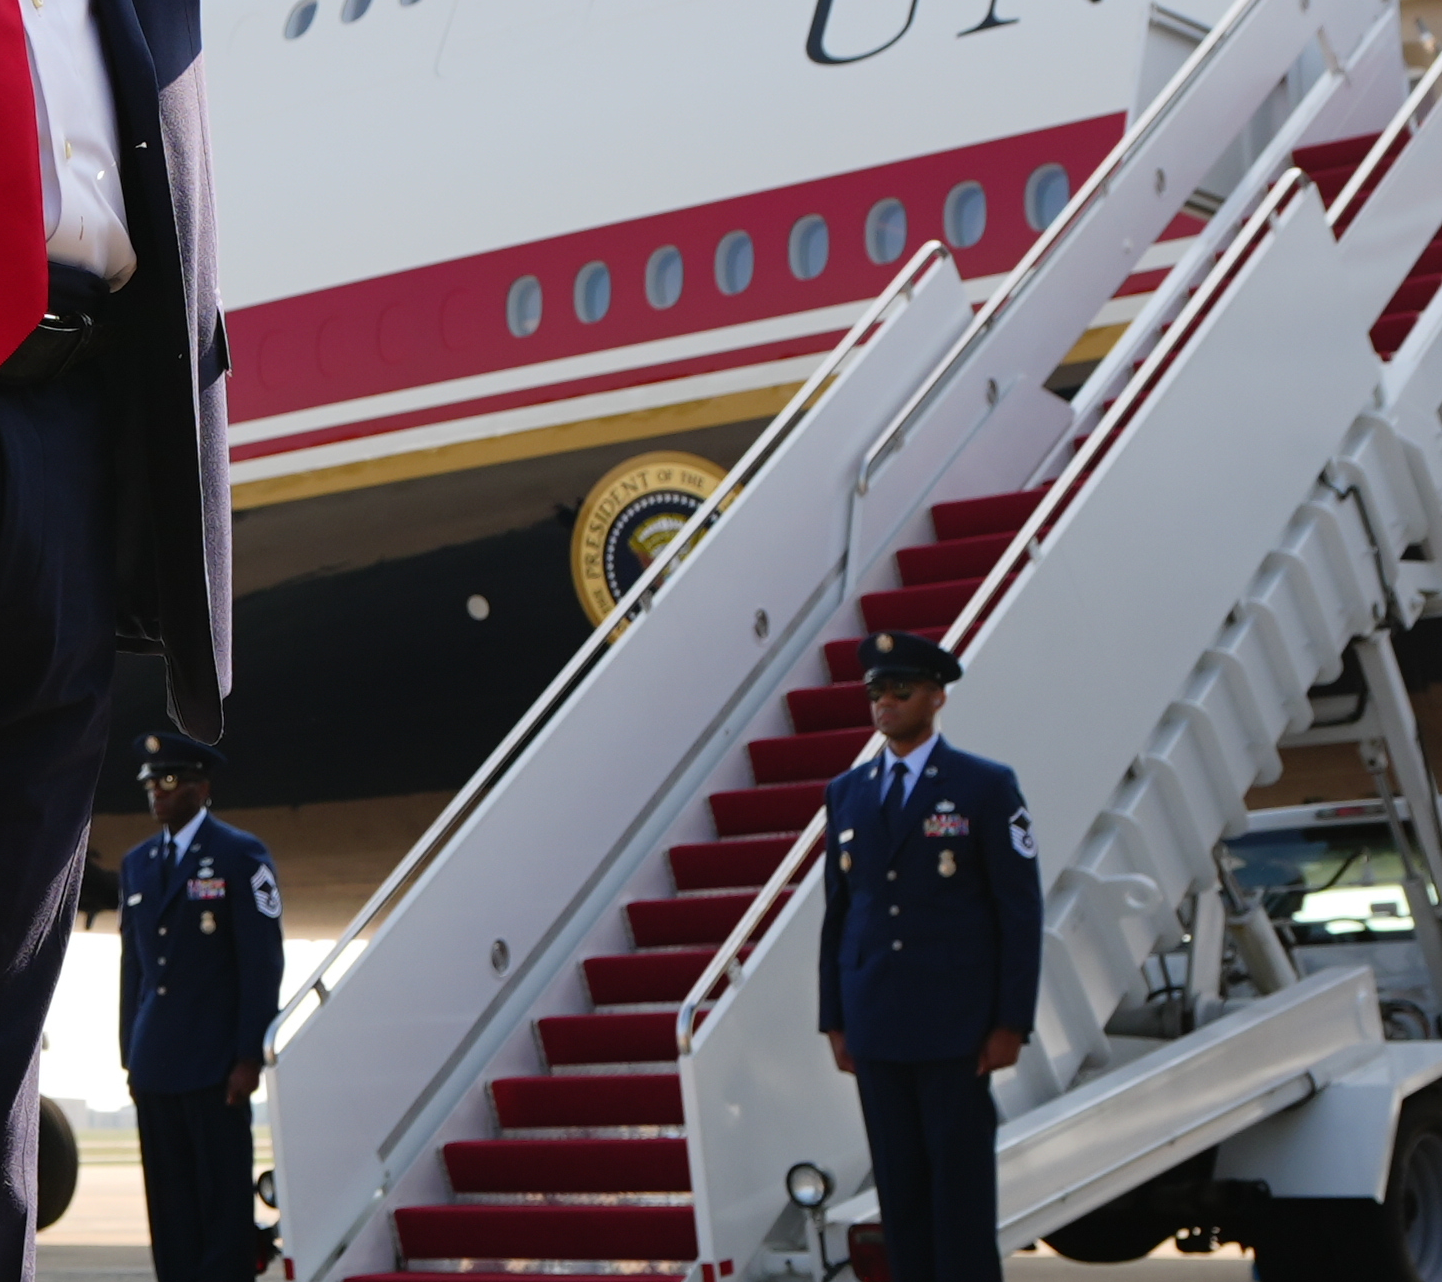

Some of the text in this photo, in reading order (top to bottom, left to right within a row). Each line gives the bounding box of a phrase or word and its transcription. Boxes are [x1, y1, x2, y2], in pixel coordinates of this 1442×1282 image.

[585, 471, 651, 580] PRESIDENT
[657, 469, 673, 483] OF
[681, 471, 705, 488] THE
